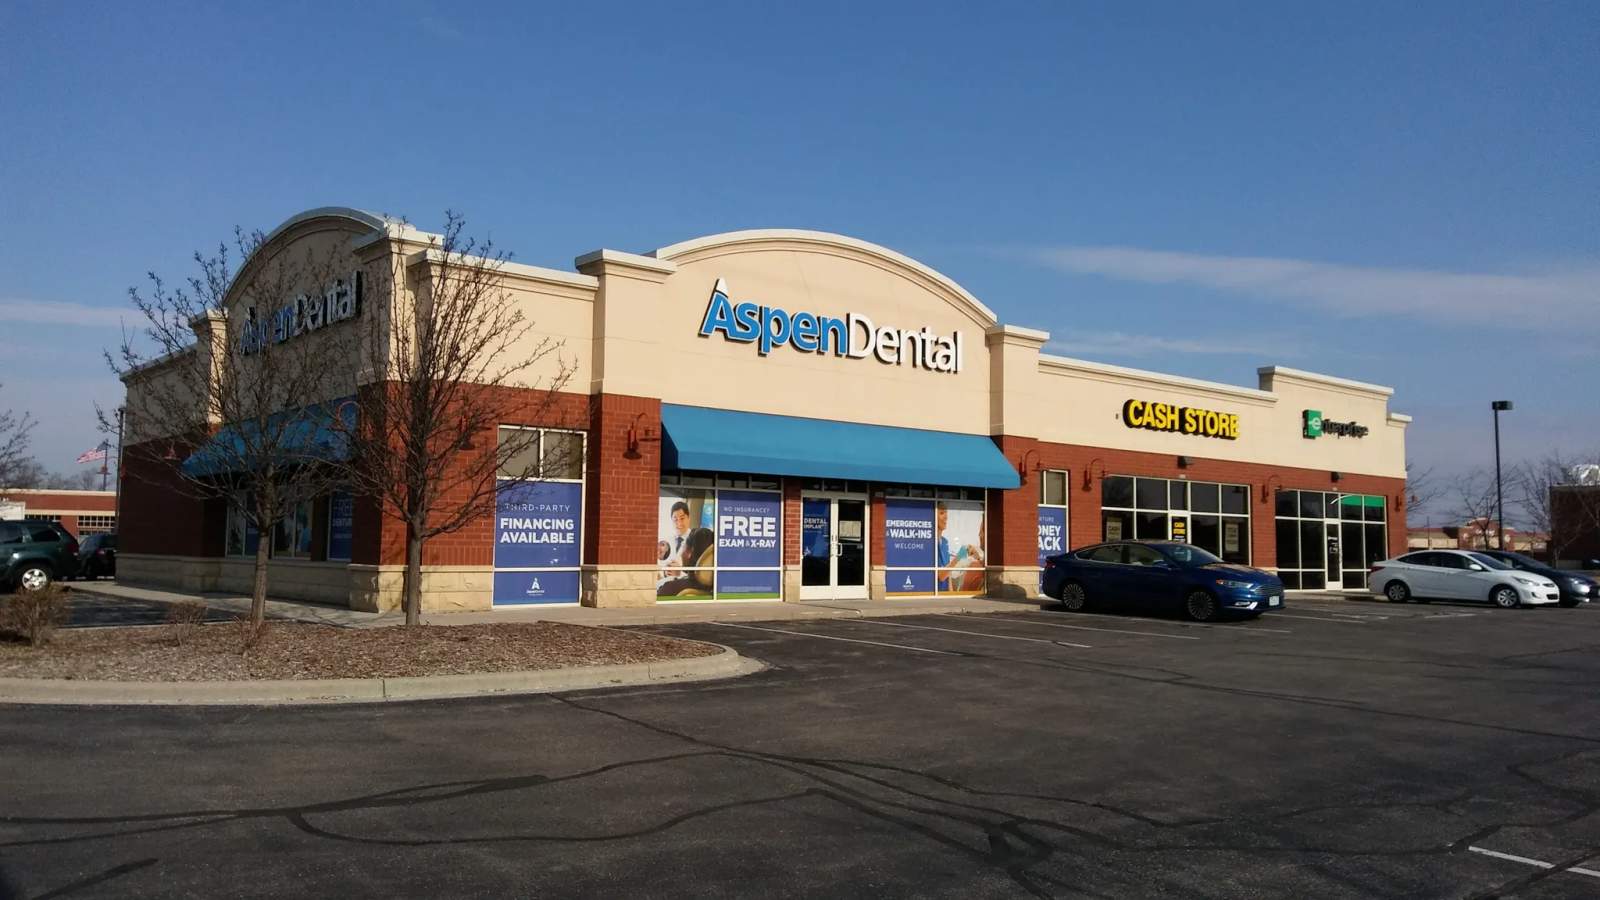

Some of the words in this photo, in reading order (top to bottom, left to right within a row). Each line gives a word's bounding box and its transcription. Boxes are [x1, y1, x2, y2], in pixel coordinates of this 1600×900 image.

[1123, 399, 1180, 432] CASH
[1182, 407, 1240, 440] STORE
[500, 518, 575, 530] FINANCING
[719, 515, 776, 537] FREE
[803, 517, 827, 525] DENTAL
[886, 519, 933, 529] EMERGENCIES
[500, 532, 575, 544] AVAILABLE
[890, 528, 933, 539] WALK-INS
[719, 538, 745, 548] EXAM
[751, 539, 776, 549] X-RAY
[894, 542, 924, 550] WELCOME
[1038, 535, 1061, 551] ACK
